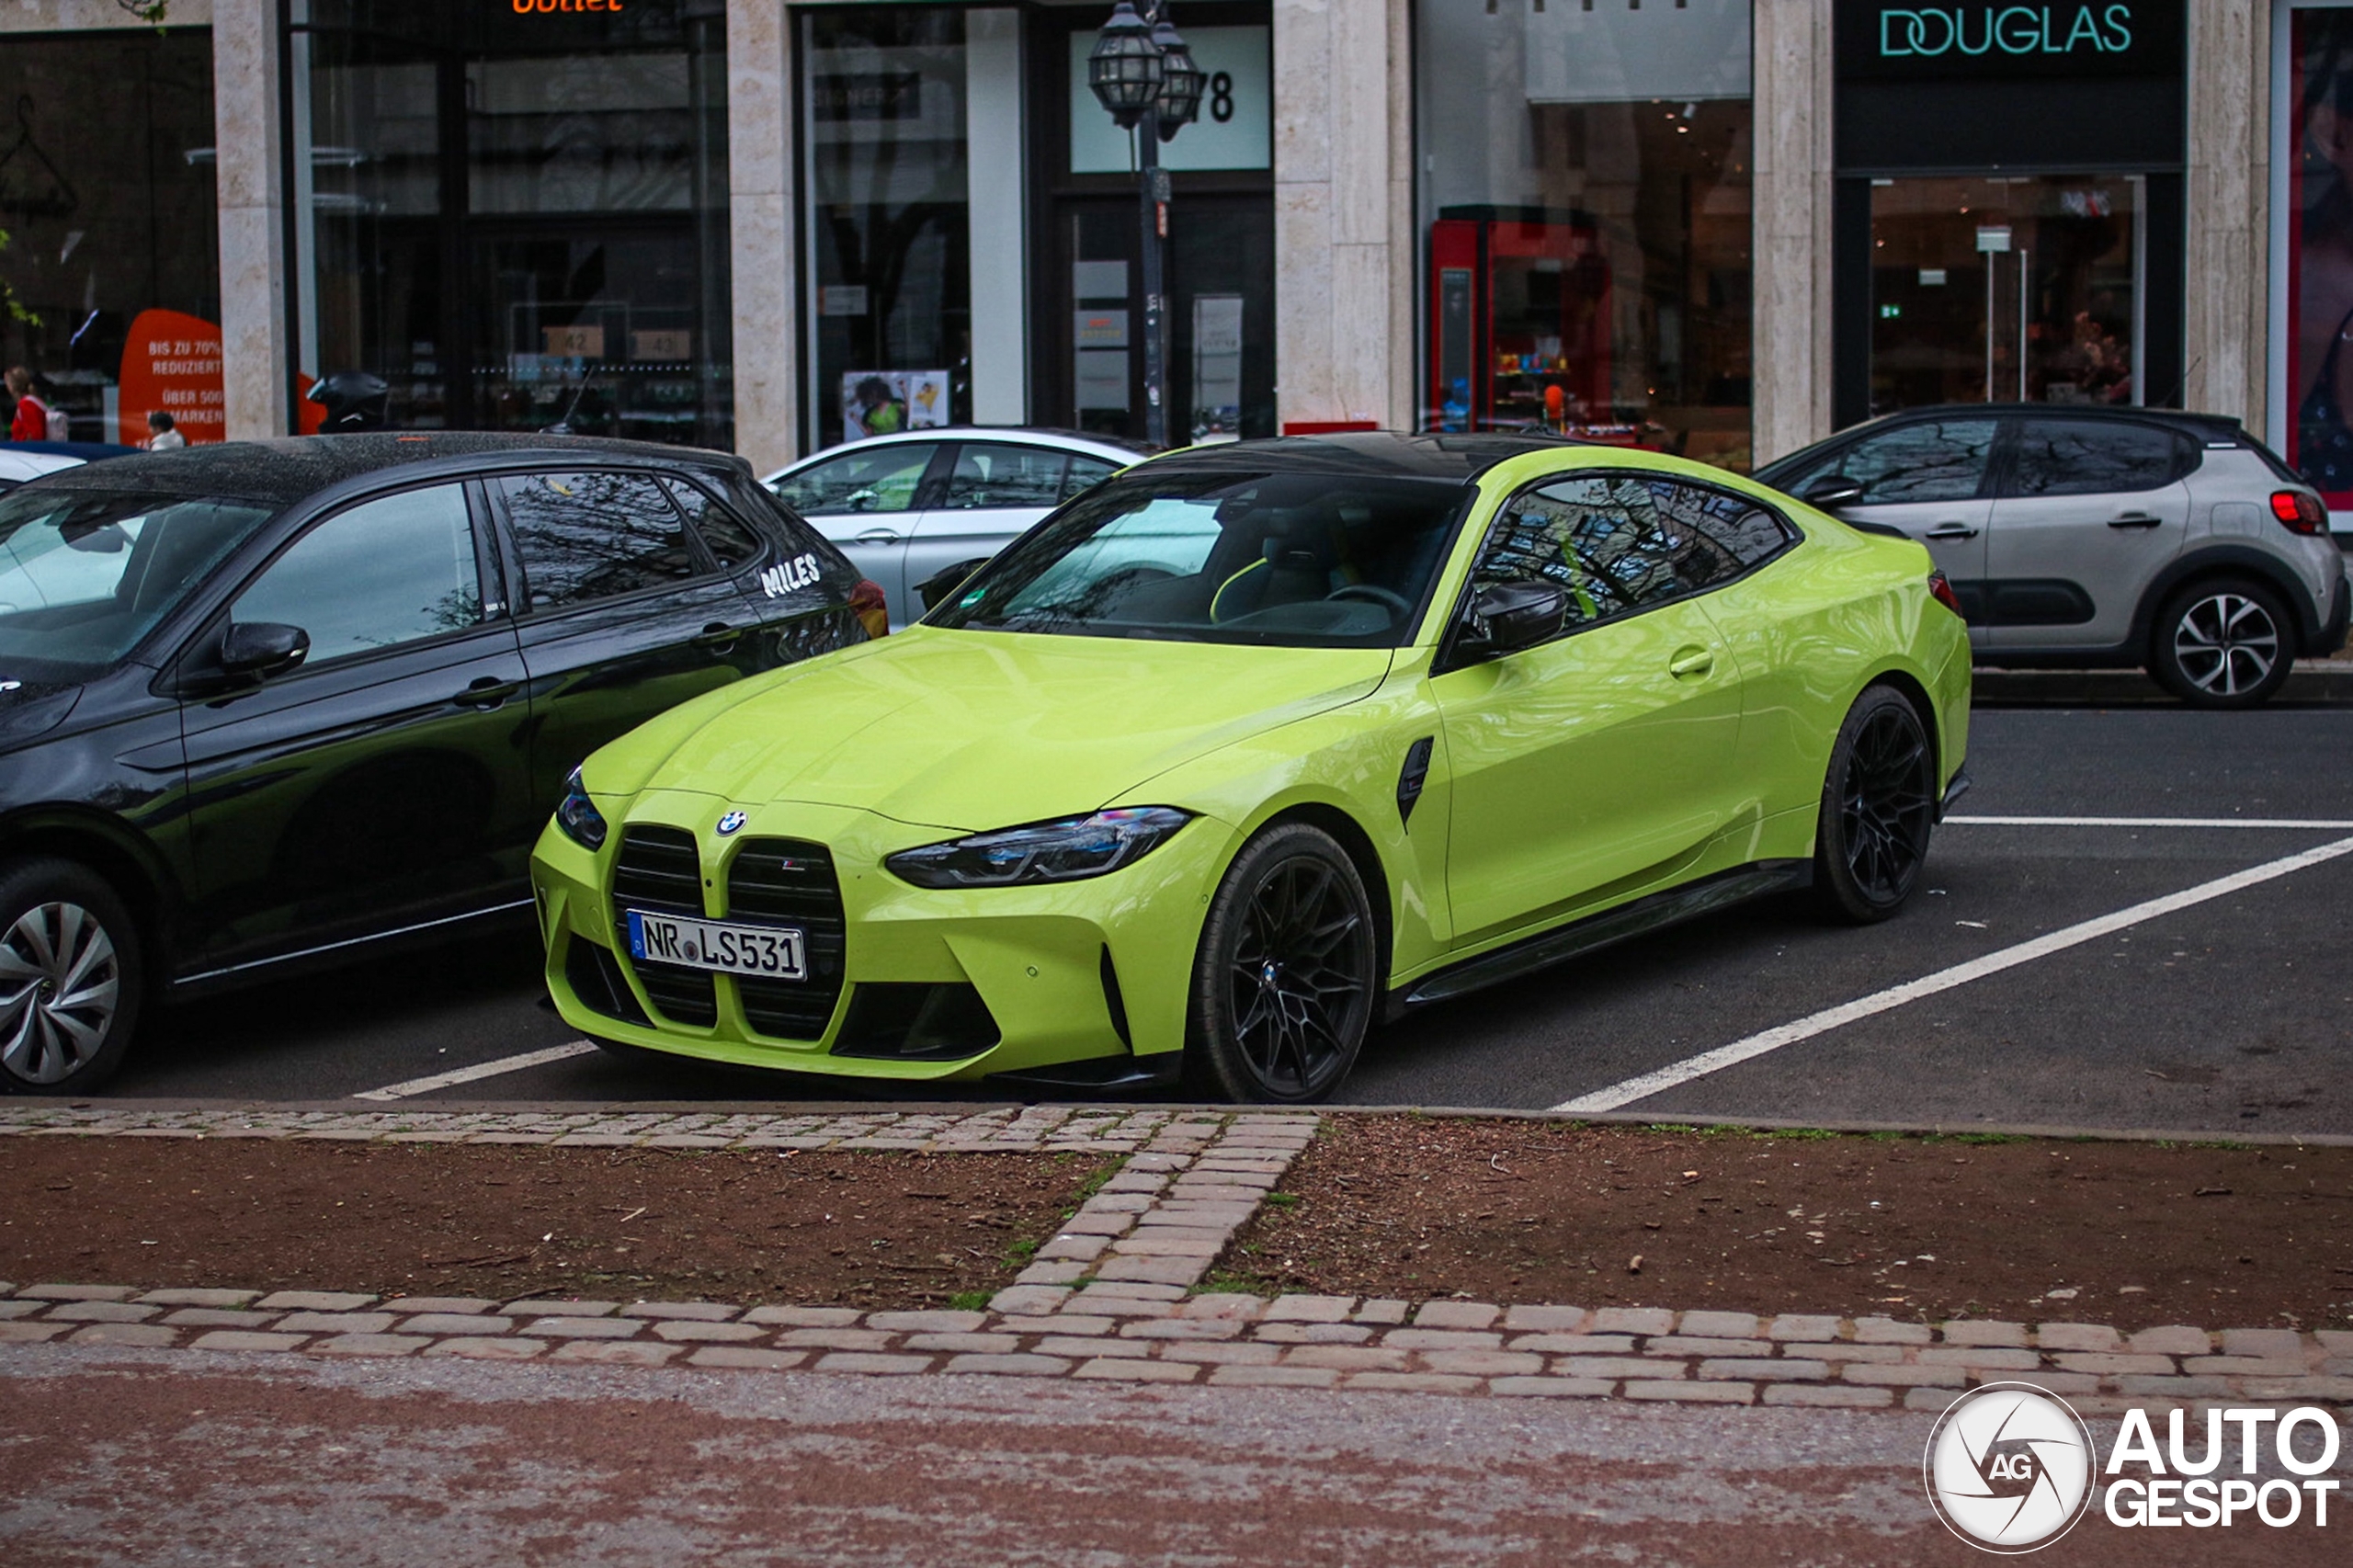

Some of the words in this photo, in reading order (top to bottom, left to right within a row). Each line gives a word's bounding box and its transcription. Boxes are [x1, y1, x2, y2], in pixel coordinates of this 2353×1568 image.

[1881, 5, 2131, 55] DOUGLAS
[148, 340, 171, 356] BIS
[174, 340, 191, 356] ZU
[152, 359, 222, 375] REDUZIERT
[163, 387, 197, 404] ÜBER
[199, 389, 223, 403] 500
[145, 409, 223, 424] TMARKEN
[761, 553, 820, 598] MILES
[644, 920, 681, 959] NR
